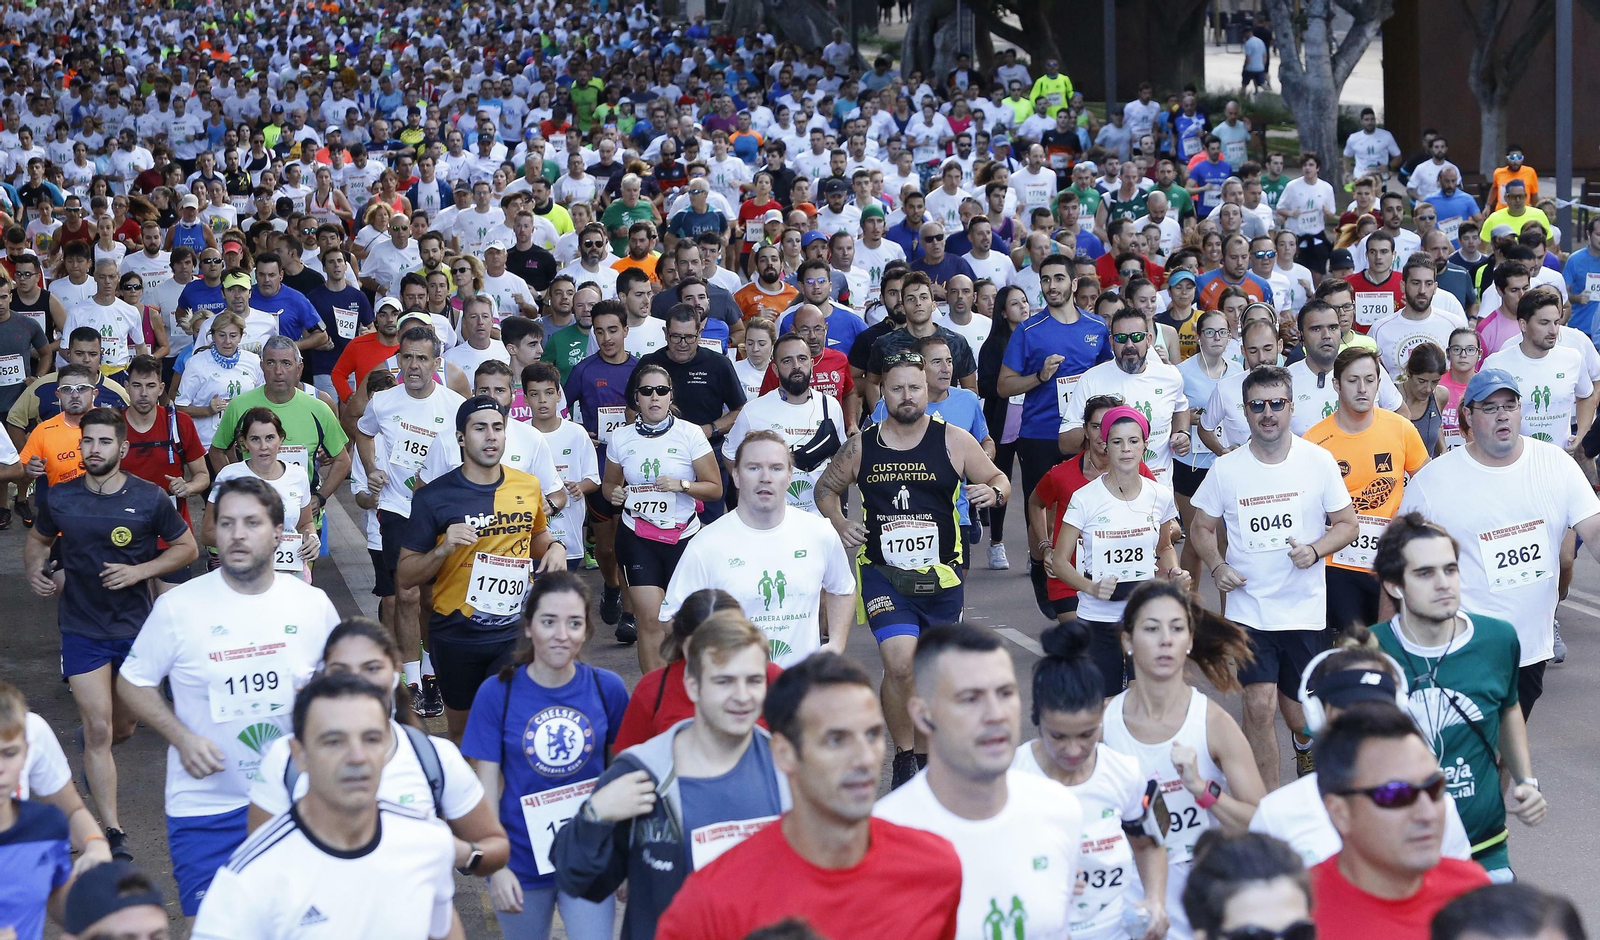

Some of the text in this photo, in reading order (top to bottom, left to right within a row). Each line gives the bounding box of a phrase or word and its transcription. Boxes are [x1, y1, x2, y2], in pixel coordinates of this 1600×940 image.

[1362, 304, 1388, 314] 3780
[1062, 392, 1073, 403] 1
[1442, 408, 1457, 417] WE
[401, 422, 409, 430] 41
[403, 439, 429, 457] 185
[872, 462, 927, 473] CUSTODIA
[866, 472, 937, 484] COMPARTIDA
[633, 501, 668, 514] 9779
[1238, 498, 1250, 507] 41
[464, 511, 533, 529] bichos
[916, 513, 933, 521] HIJOS
[1249, 513, 1293, 533] 6046
[882, 524, 893, 532] 41
[1094, 530, 1106, 539] 41
[1479, 519, 1545, 542] 41 CARRERA URBANA
[886, 534, 935, 555] 17057
[275, 551, 295, 564] 23
[1103, 547, 1145, 565] 1328
[1495, 543, 1542, 570] 2862
[476, 575, 525, 596] 17030
[749, 612, 808, 623] CARRERA URBANA
[209, 651, 223, 663] 41
[225, 670, 279, 696] 1199
[534, 708, 582, 725] CHELSEA
[524, 795, 541, 808] 41
[1168, 806, 1201, 833] 92
[546, 817, 573, 836] 1
